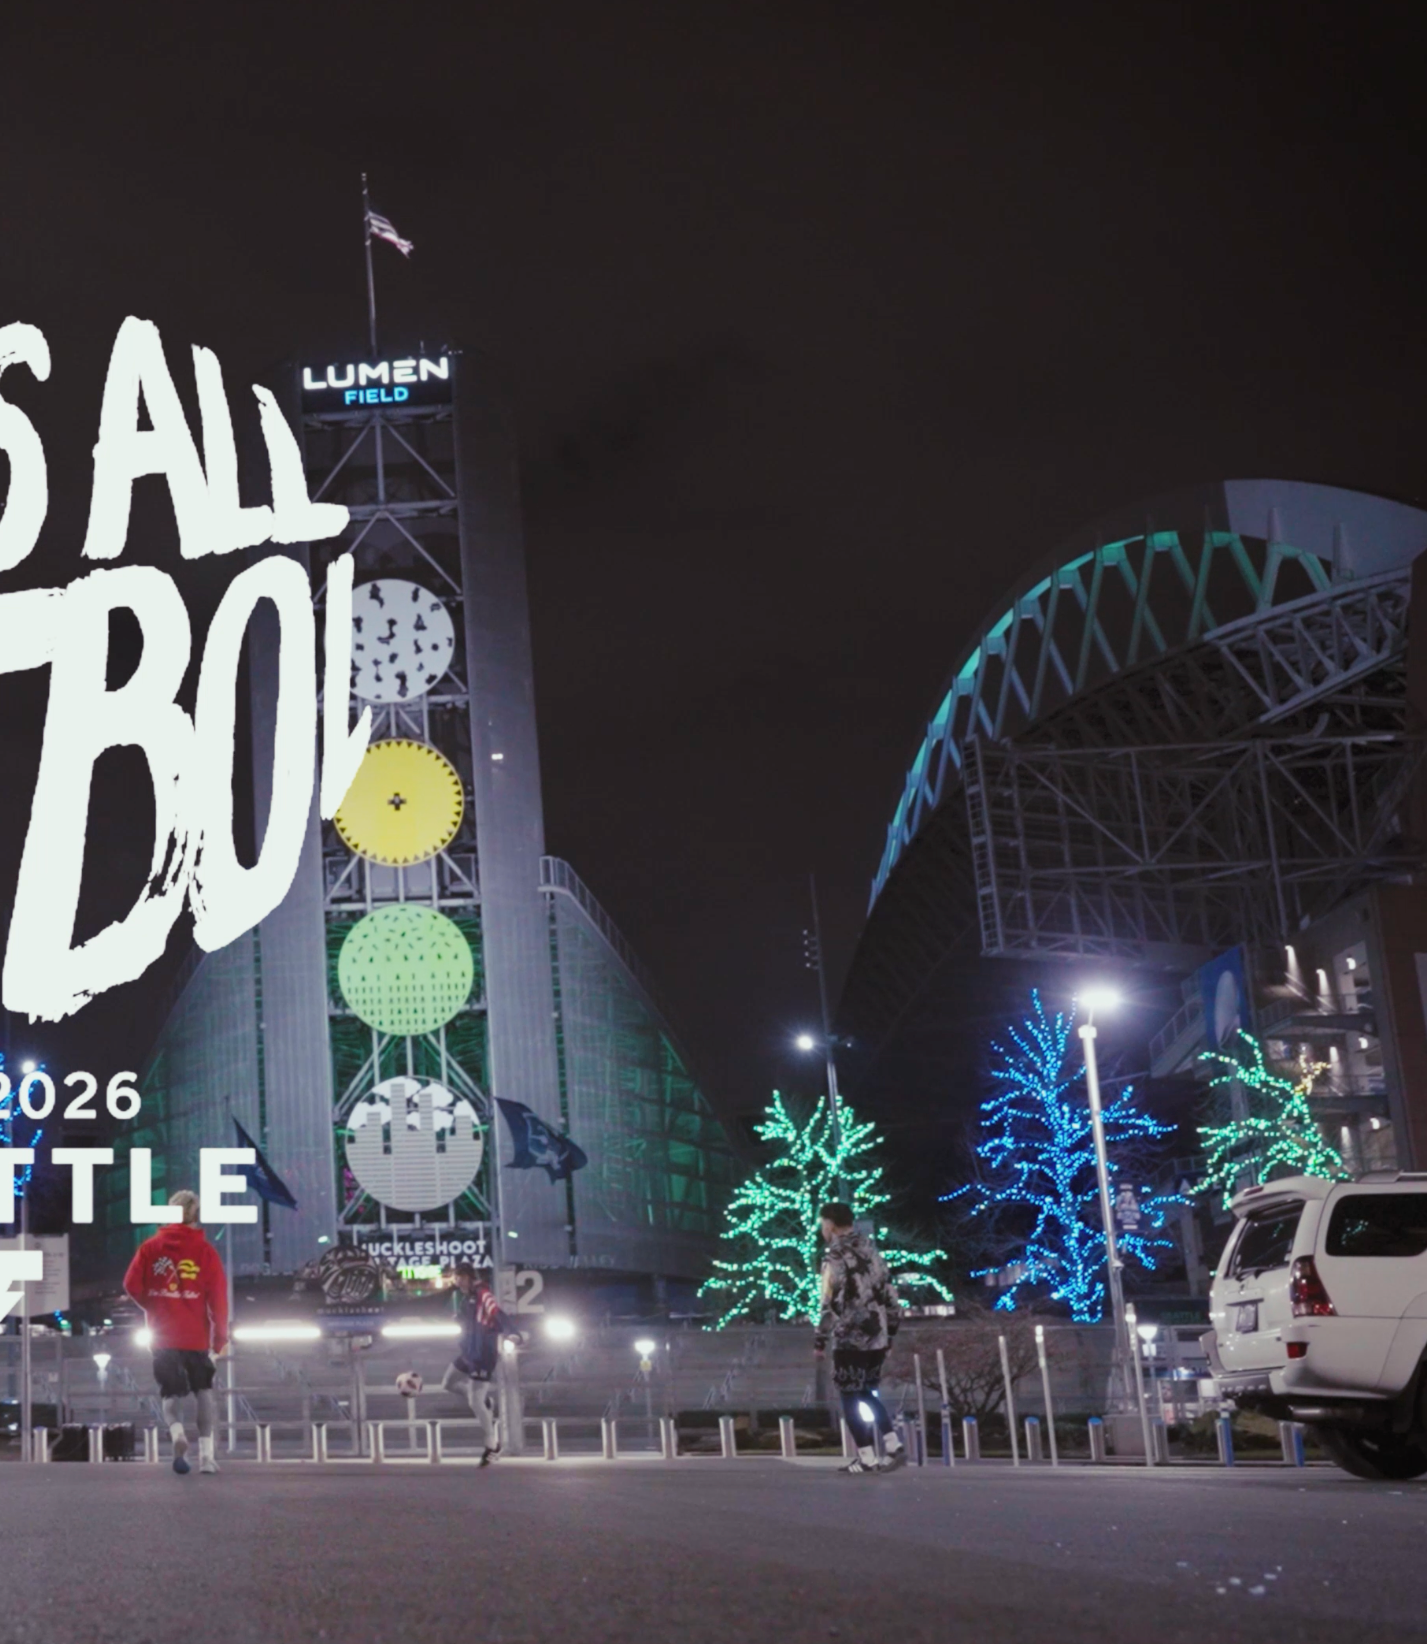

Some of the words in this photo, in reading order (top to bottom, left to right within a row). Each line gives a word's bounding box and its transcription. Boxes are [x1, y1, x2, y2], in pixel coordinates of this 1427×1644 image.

[303, 356, 449, 390] LUMEN
[344, 387, 409, 405] FIELD
[361, 1240, 487, 1256] UCKLESHOOT
